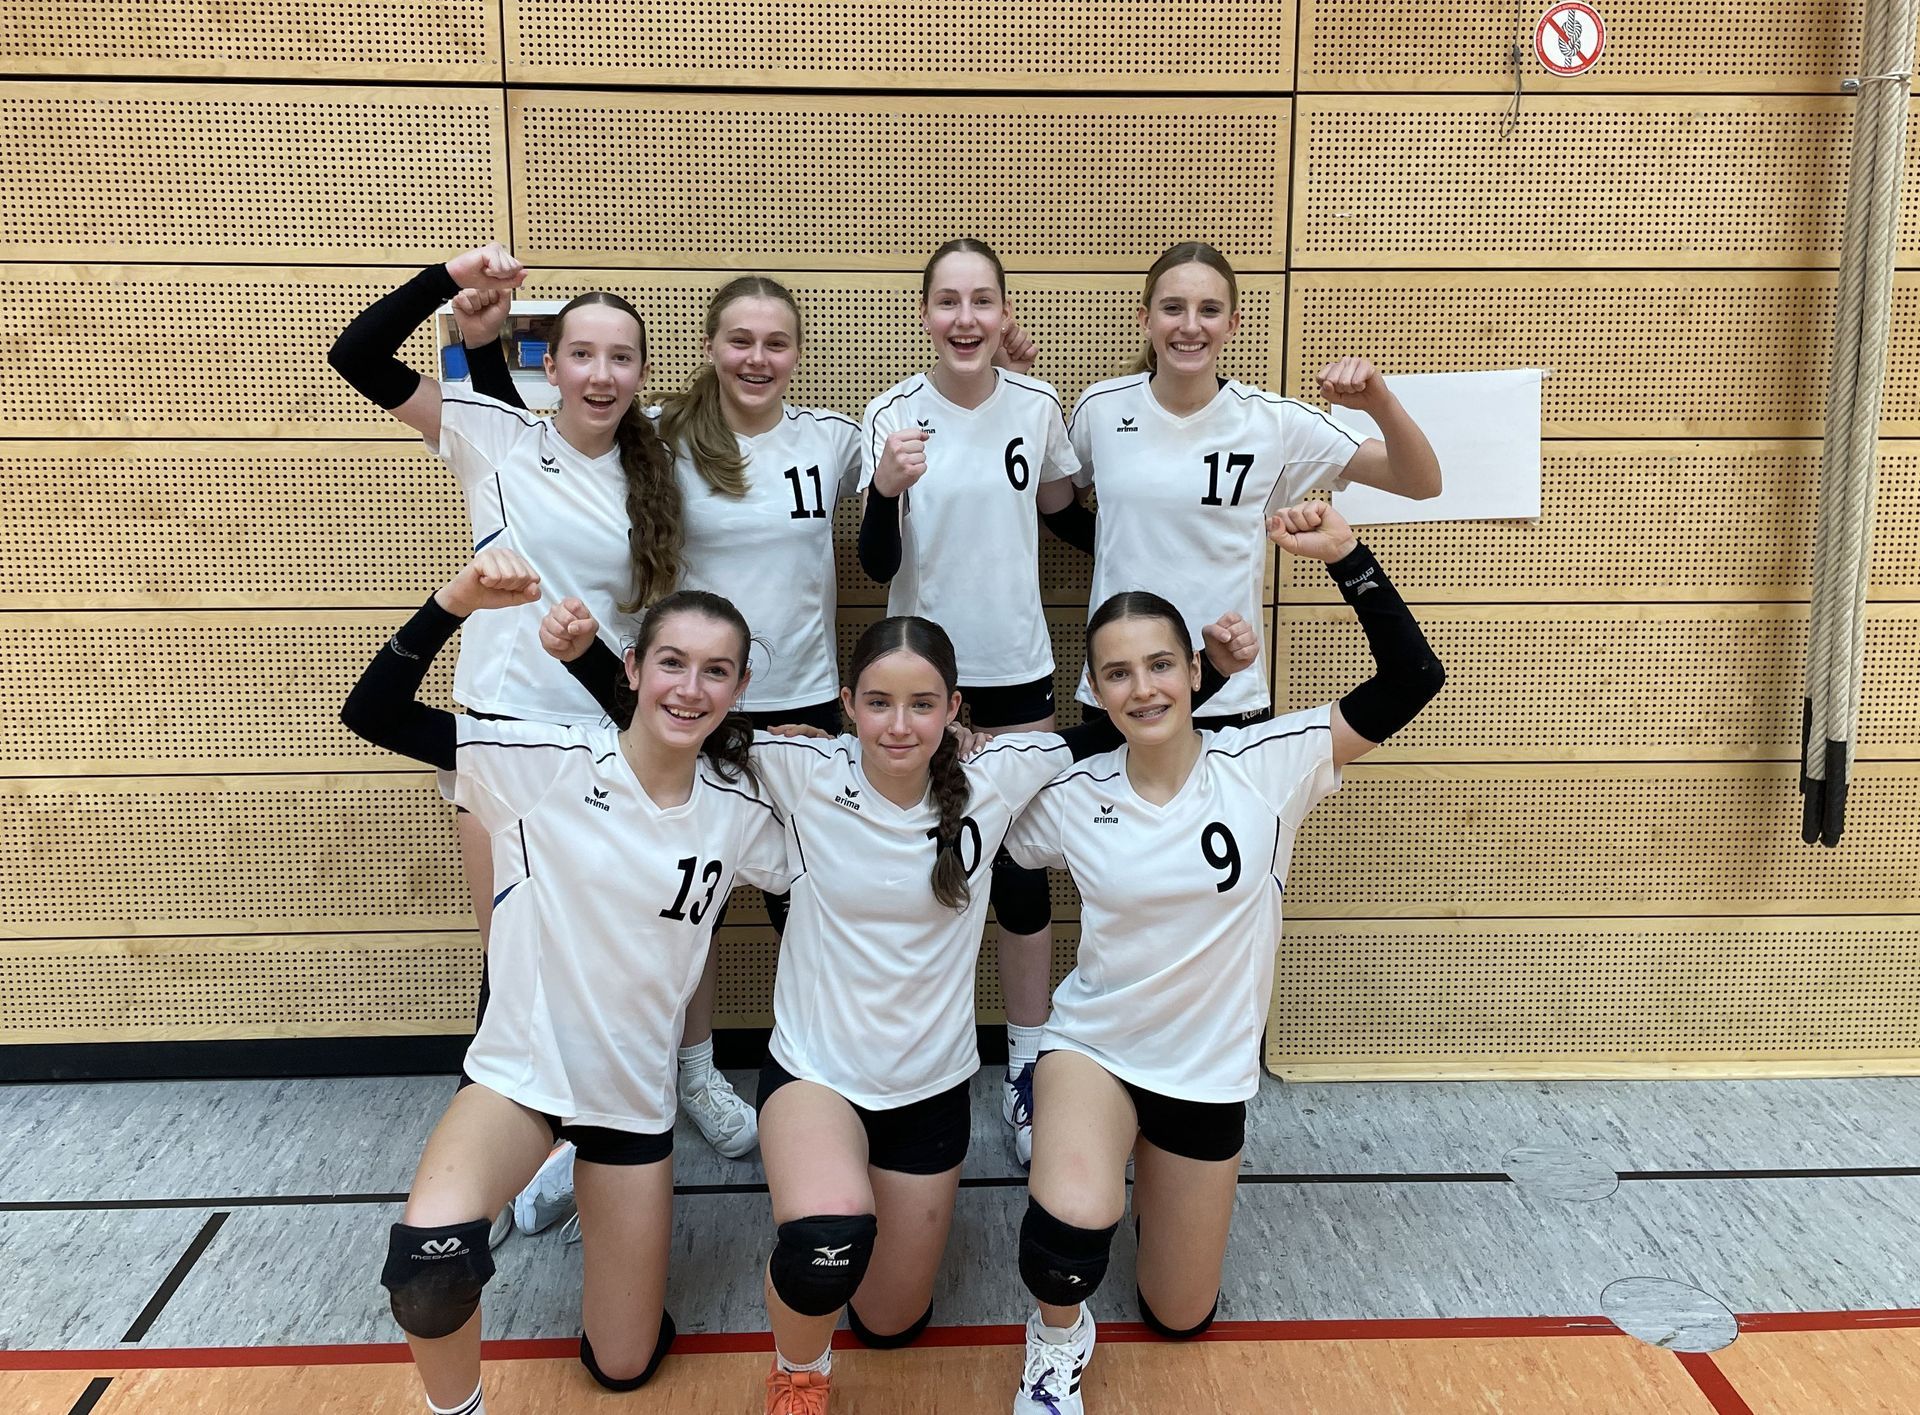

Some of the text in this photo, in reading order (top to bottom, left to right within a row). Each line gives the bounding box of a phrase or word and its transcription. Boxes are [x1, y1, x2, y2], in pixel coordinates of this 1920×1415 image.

[541, 465, 560, 474] rima
[1005, 437, 1029, 491] 6
[1201, 452, 1254, 506] 17
[784, 465, 826, 519] 11
[584, 795, 610, 812] erima
[835, 795, 860, 811] erima
[1094, 816, 1119, 824] erima
[1201, 821, 1241, 893] 9
[659, 856, 723, 925] 13
